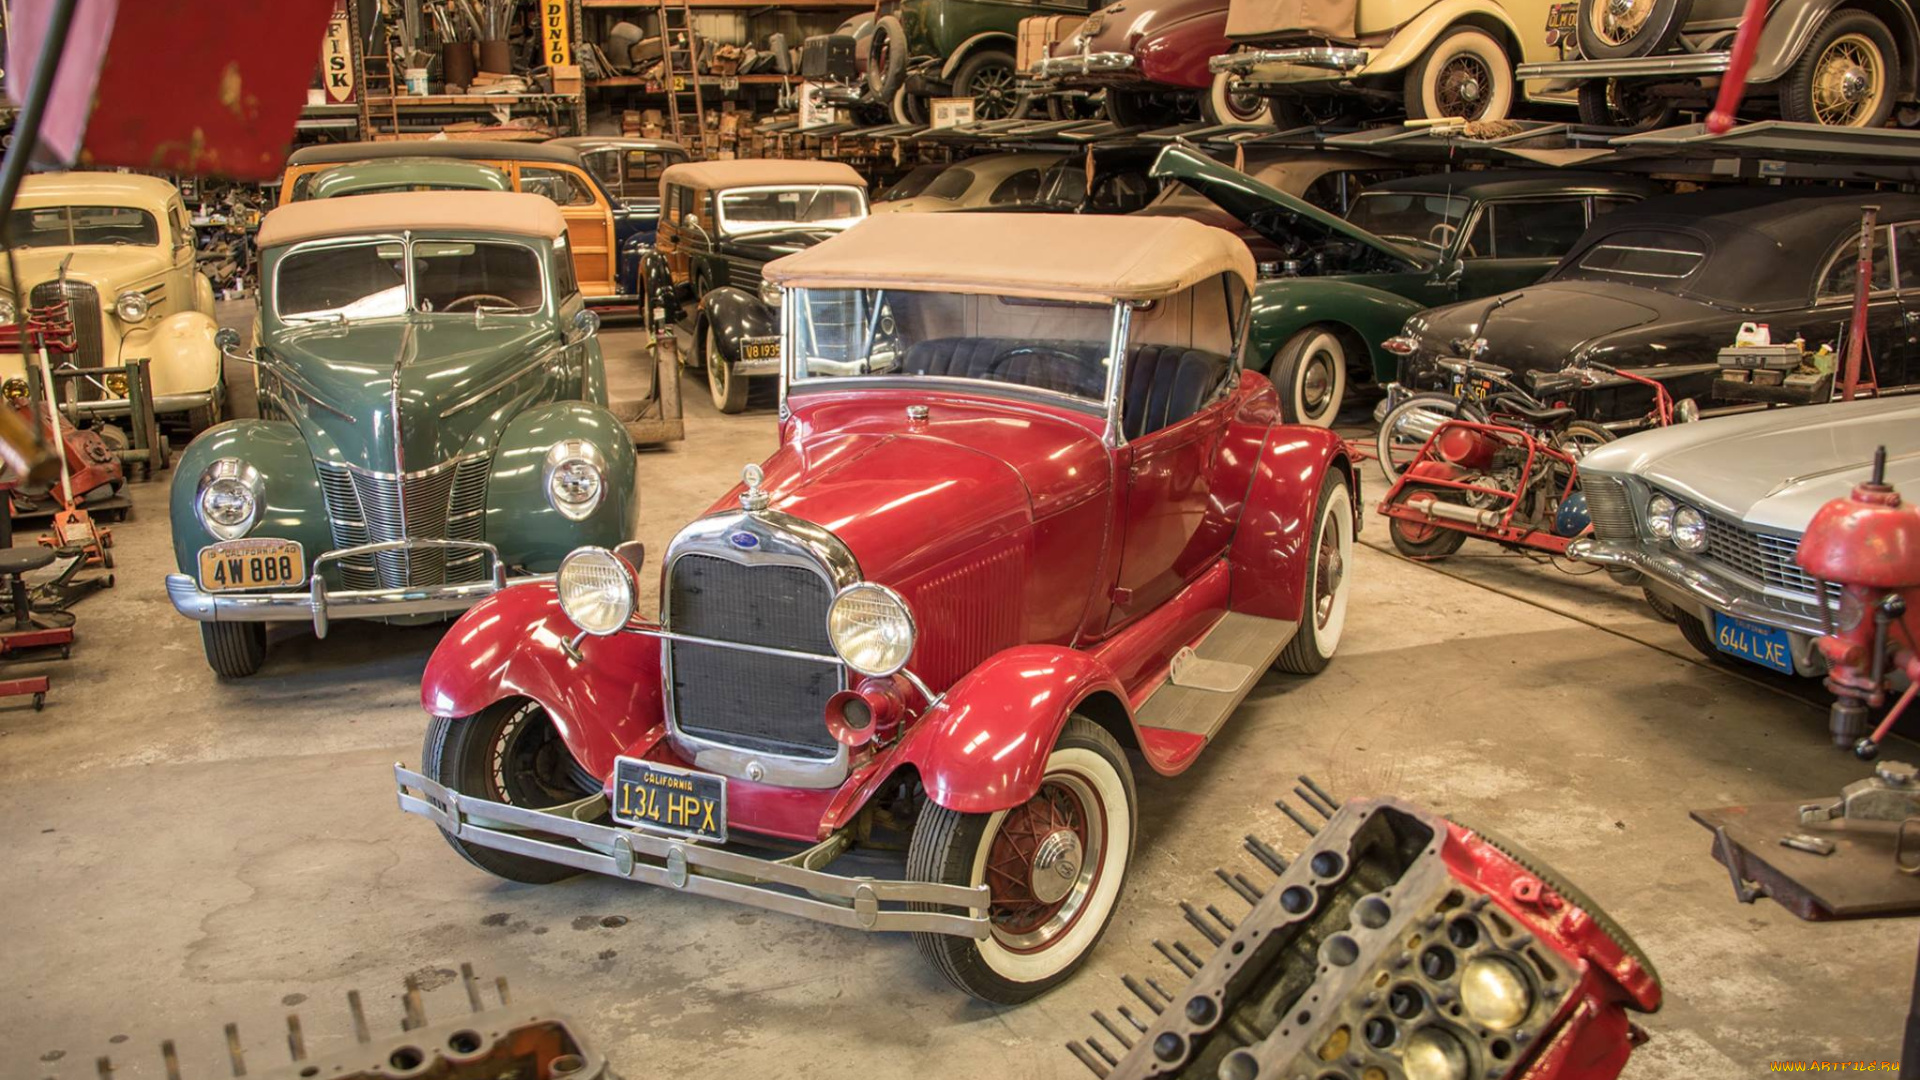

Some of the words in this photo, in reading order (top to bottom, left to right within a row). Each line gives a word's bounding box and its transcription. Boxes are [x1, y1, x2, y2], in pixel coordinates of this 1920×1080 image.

[328, 22, 350, 87] FISK
[547, 4, 564, 64] DUNLO
[214, 558, 243, 585] 4W
[250, 555, 292, 582] 888
[224, 547, 277, 558] CALIFORNIA
[1720, 625, 1748, 653] 644
[1752, 635, 1787, 668] LXE
[643, 772, 694, 793] CALIFORNIA
[619, 782, 660, 821] 134
[667, 792, 716, 832] HPX
